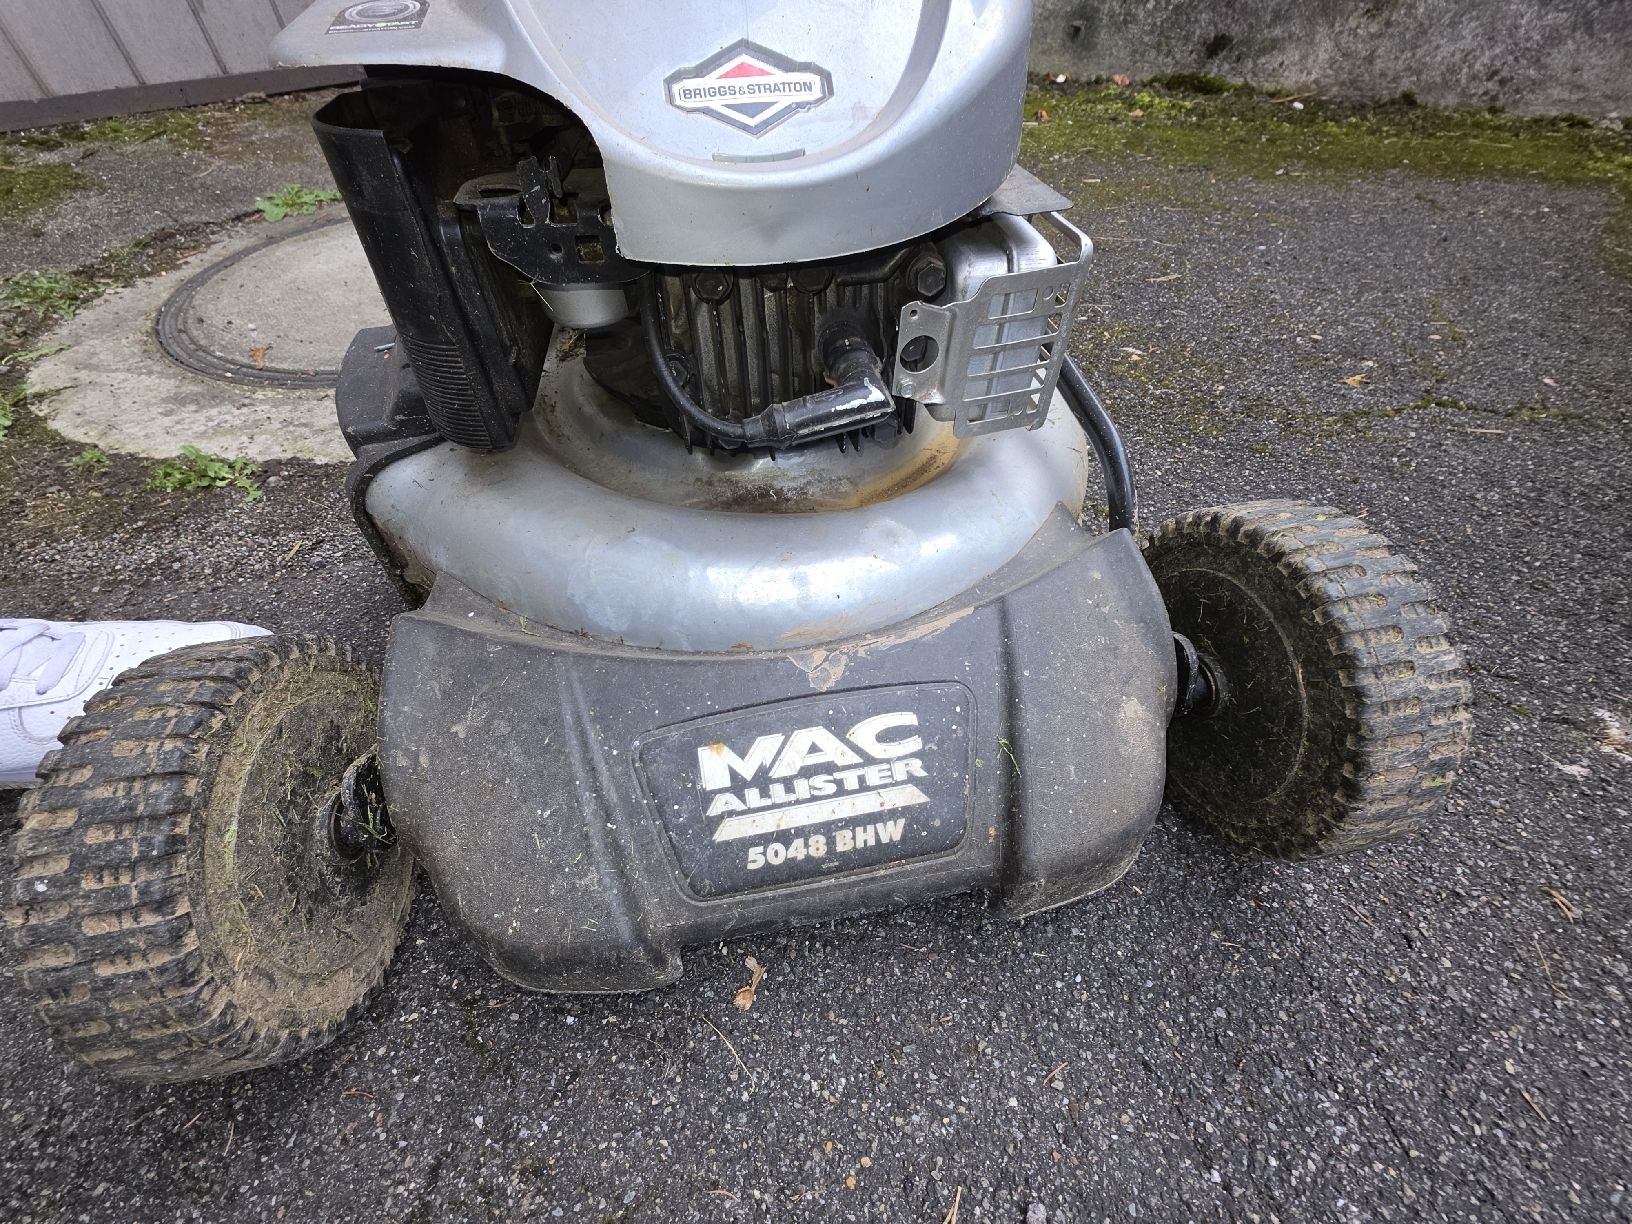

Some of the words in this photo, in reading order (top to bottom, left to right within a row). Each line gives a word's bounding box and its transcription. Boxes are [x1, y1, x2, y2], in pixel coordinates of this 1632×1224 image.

[682, 82, 813, 100] BRIGGS&STRATTON
[697, 712, 923, 791] MAC
[706, 758, 928, 817] ALLISTER
[747, 835, 827, 870] 5048
[836, 818, 906, 852] BHW
